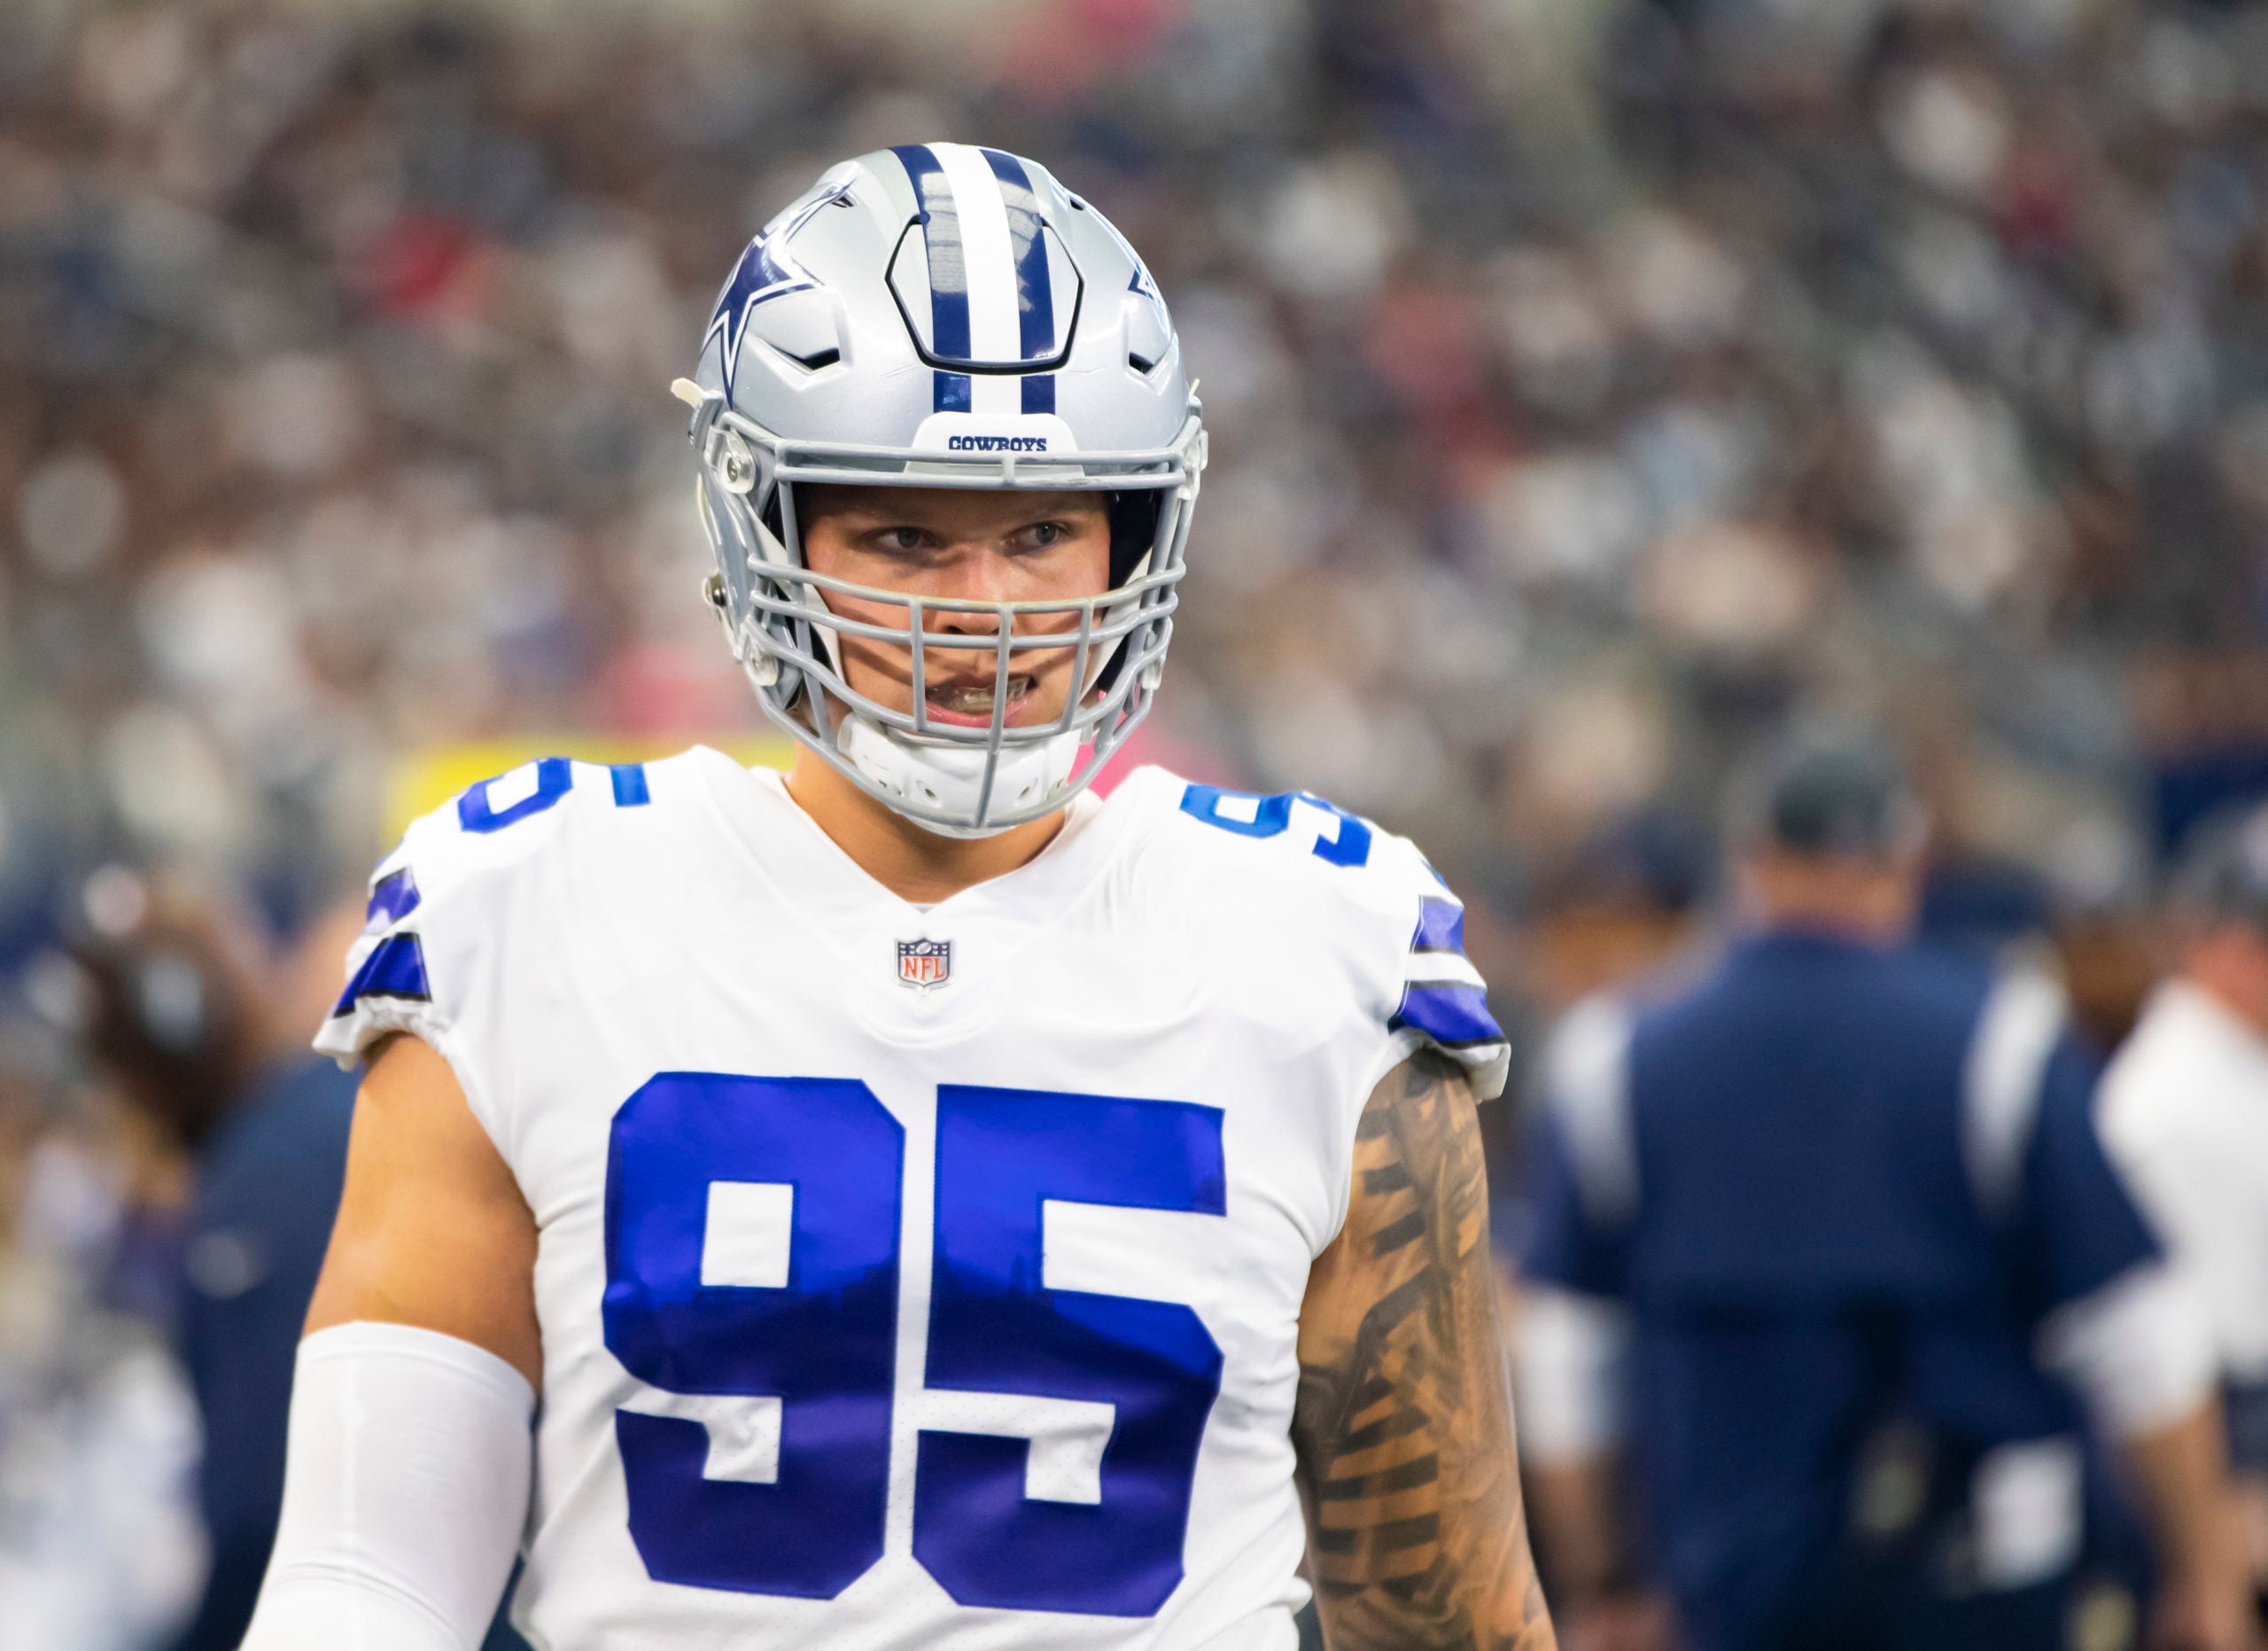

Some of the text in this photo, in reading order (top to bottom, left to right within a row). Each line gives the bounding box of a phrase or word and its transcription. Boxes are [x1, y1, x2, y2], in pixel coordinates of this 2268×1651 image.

[949, 435, 1047, 452] COWBOYS
[903, 957, 946, 981] NFL
[602, 1071, 1228, 1618] 95
